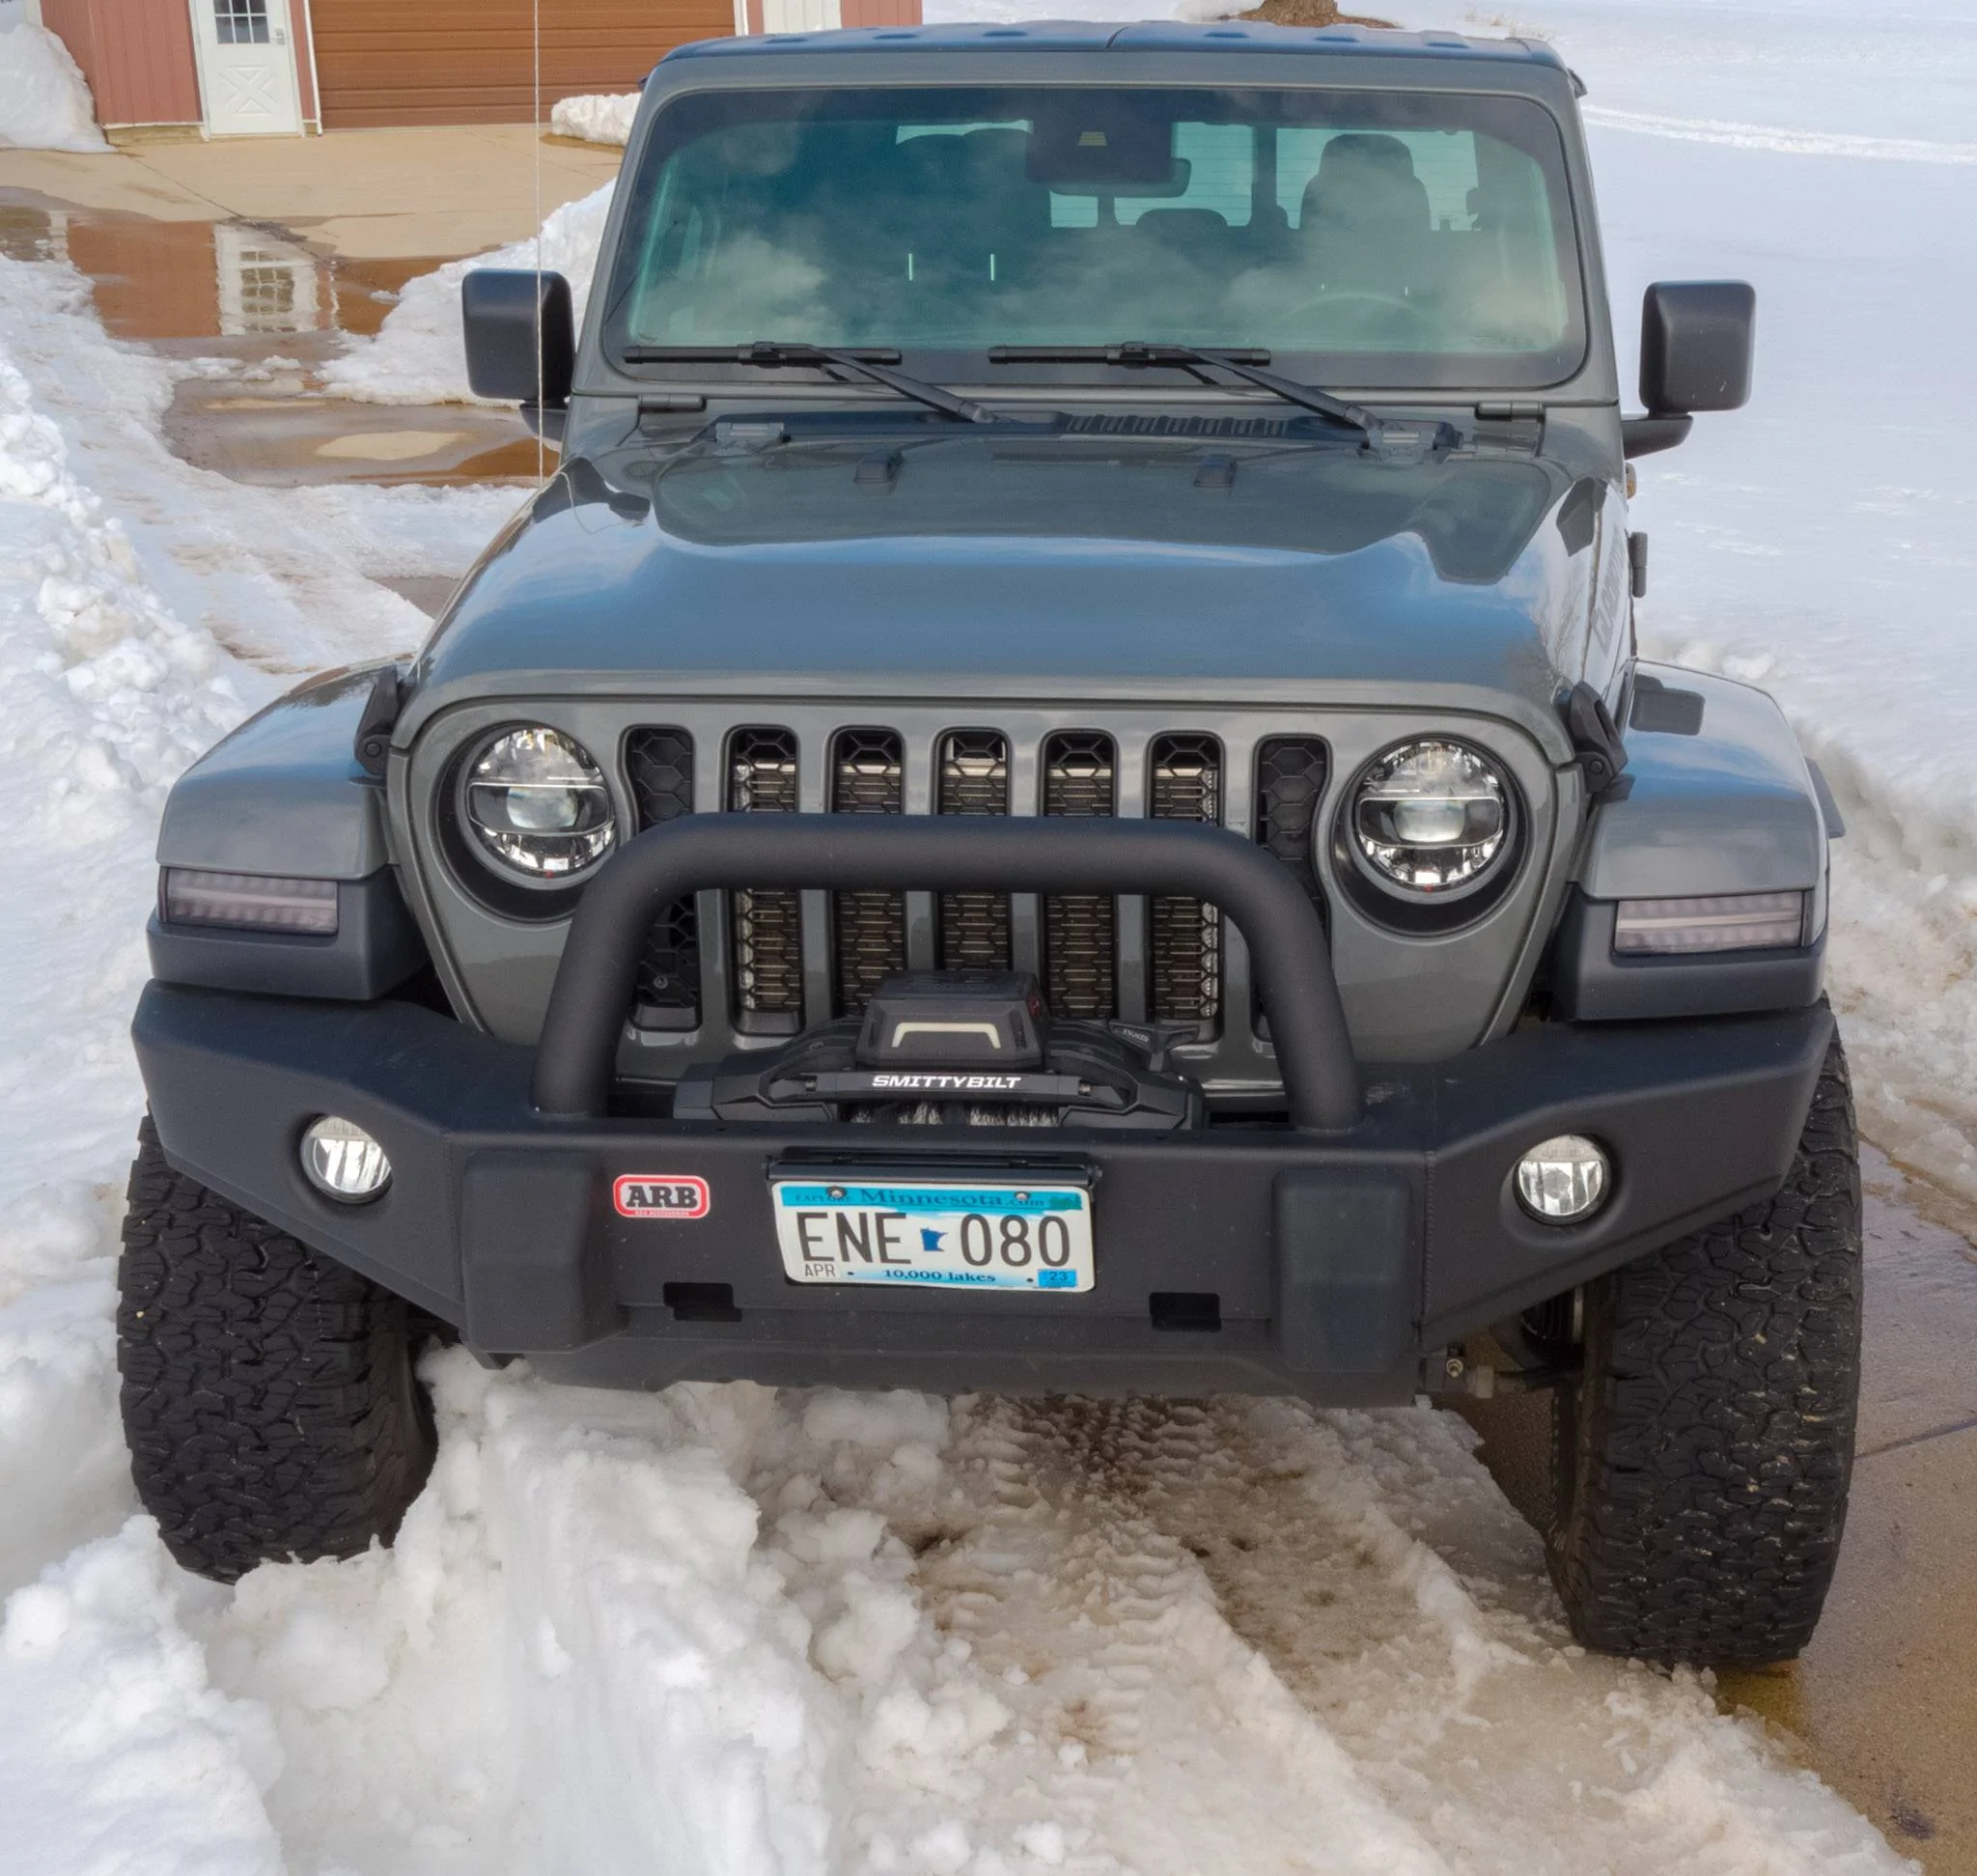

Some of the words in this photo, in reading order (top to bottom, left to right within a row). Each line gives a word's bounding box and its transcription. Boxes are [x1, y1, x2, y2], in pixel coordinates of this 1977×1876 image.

[872, 1075, 1021, 1088] SMITTYBILT
[626, 1186, 698, 1209] ARB
[796, 1212, 911, 1264] ENE
[960, 1214, 1071, 1267] 080
[804, 1263, 836, 1277] APR
[883, 1270, 942, 1280] 10,000
[948, 1272, 996, 1282] lakes
[1049, 1271, 1068, 1281] 23
